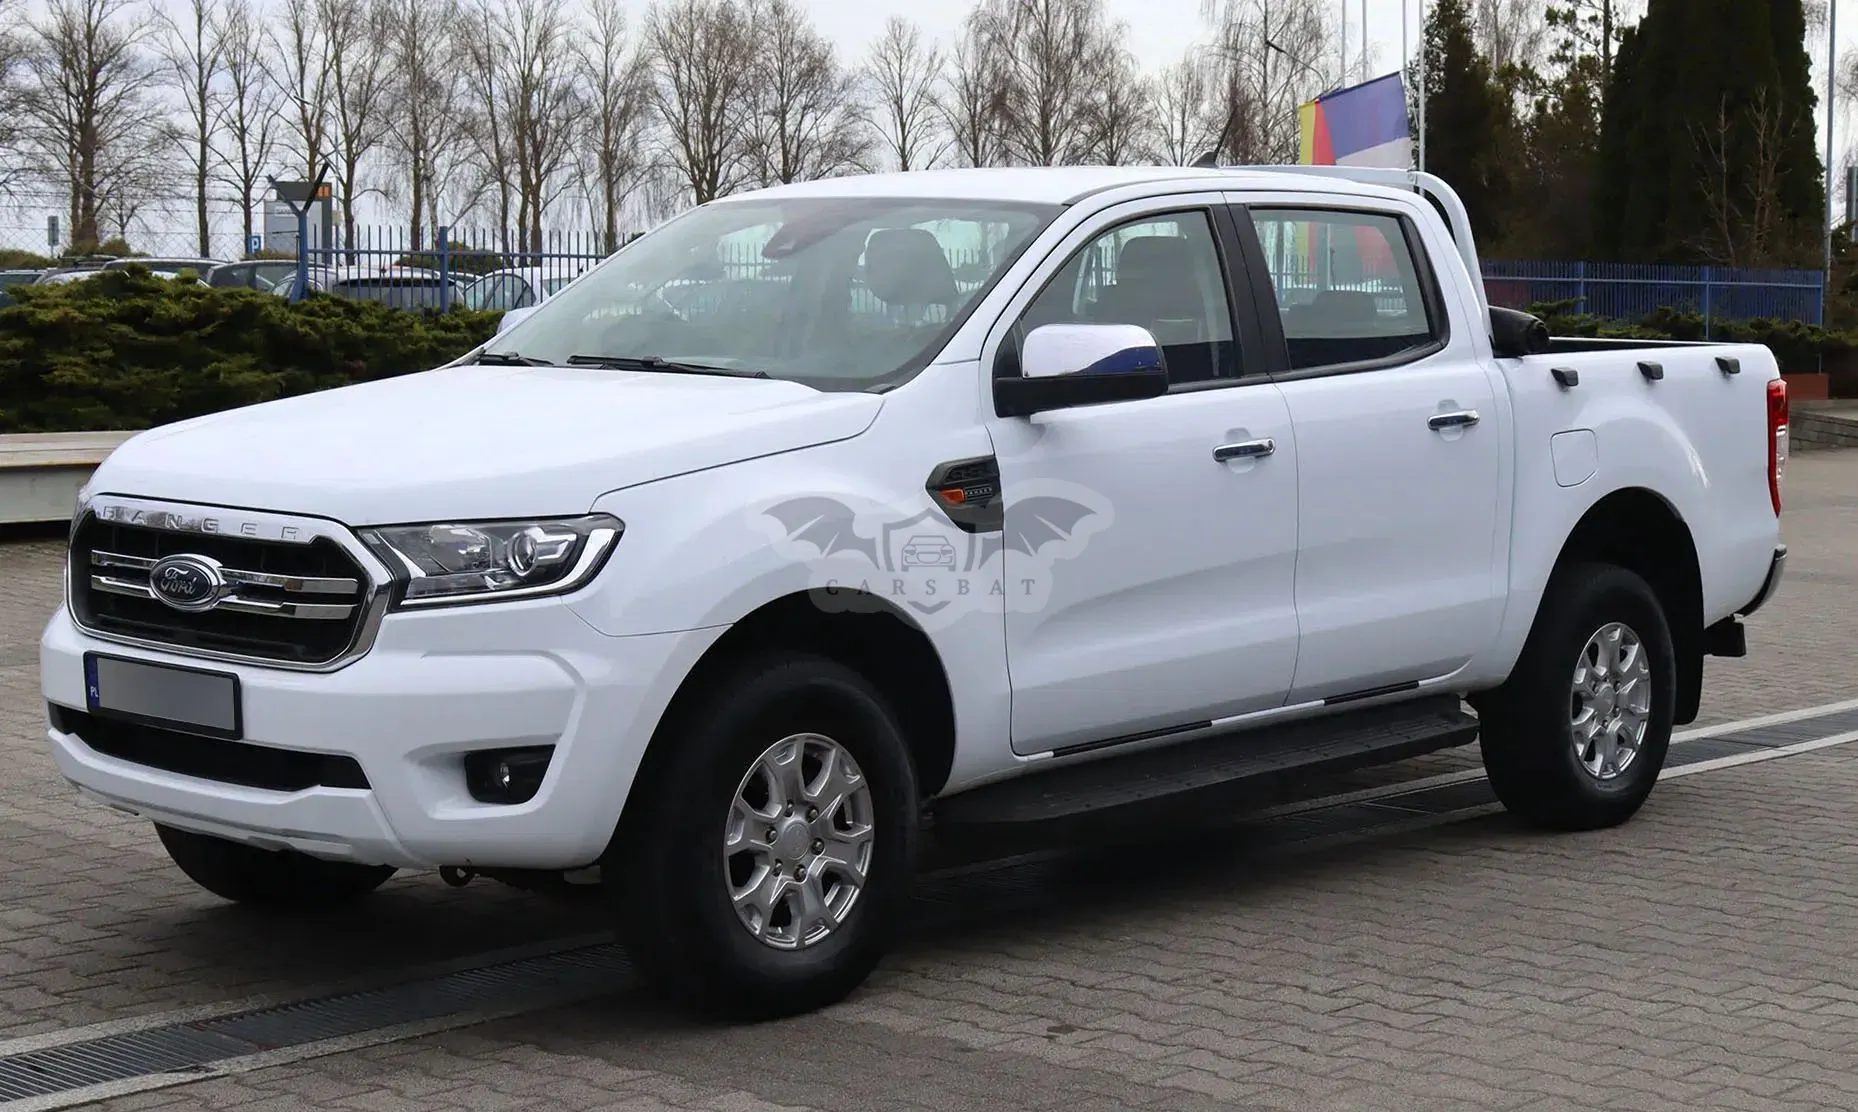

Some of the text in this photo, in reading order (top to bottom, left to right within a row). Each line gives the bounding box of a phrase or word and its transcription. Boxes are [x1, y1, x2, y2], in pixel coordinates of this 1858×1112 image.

[251, 237, 260, 254] P
[102, 506, 300, 540] RANGER
[159, 567, 197, 596] Ford
[90, 686, 99, 698] PL
